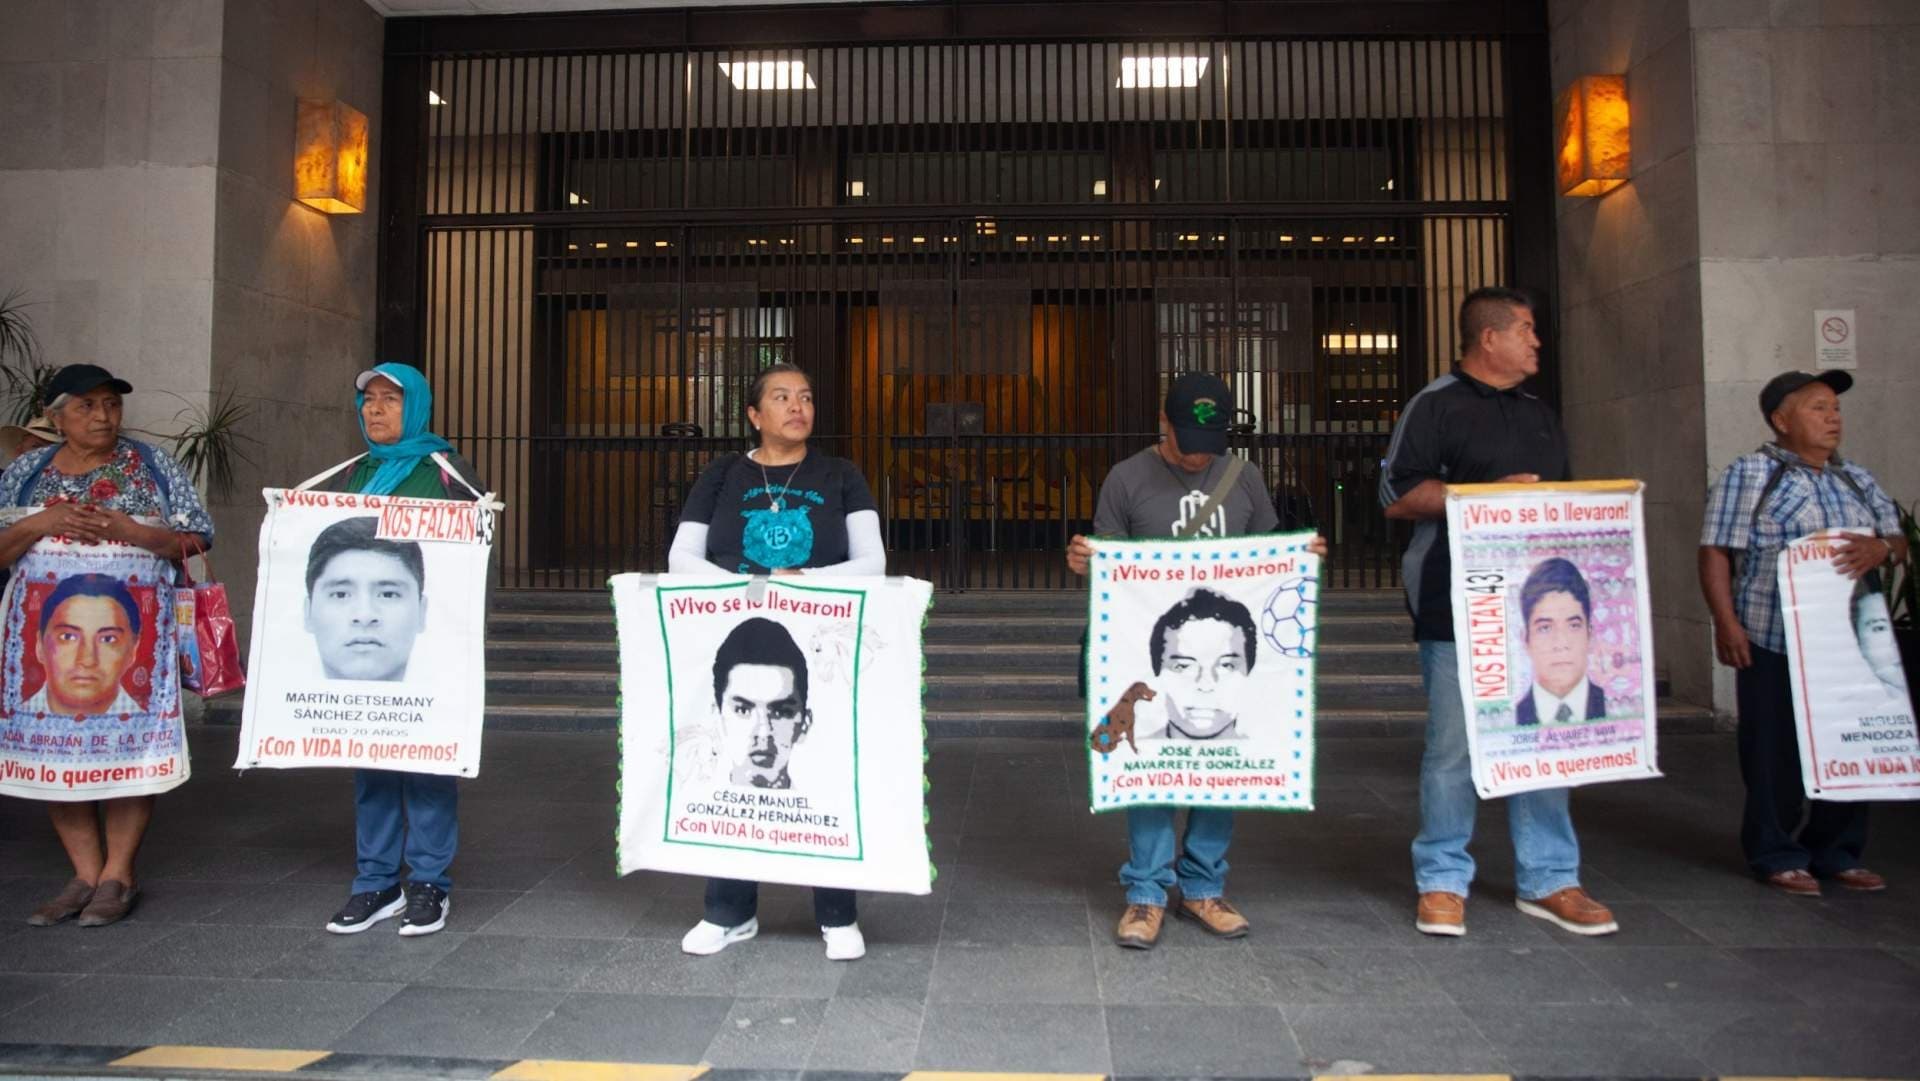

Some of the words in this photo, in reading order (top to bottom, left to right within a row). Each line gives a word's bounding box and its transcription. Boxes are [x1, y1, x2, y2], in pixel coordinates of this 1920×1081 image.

[335, 495, 357, 508] se
[379, 504, 413, 537] NOS
[1463, 502, 1512, 530] ¡Vivo
[1518, 505, 1538, 523] se
[1543, 502, 1559, 521] lo
[1563, 501, 1629, 521] llevaron!
[1112, 564, 1160, 582] ¡Vivo
[1166, 569, 1185, 581] se
[1191, 565, 1207, 581] lo
[1213, 558, 1295, 580] llevaron!
[722, 598, 742, 613] se
[768, 590, 852, 618] llevaron!
[1475, 661, 1505, 698] NOS
[285, 692, 339, 704] MARTÍN
[343, 694, 435, 707] GETSEMANY
[293, 708, 363, 721] SÁNCHEZ
[367, 711, 424, 723] GARCÍA
[30, 733, 82, 747] ABRAJÁN
[91, 735, 108, 746] DE
[118, 733, 135, 745] LA
[142, 730, 173, 743] CRUZ
[311, 726, 348, 735] EDAD
[372, 727, 409, 737] AÑOS
[1840, 729, 1914, 742] MENDOZA
[257, 736, 295, 758] ¡Con
[302, 737, 342, 757] VIDA
[347, 739, 364, 758] lo
[368, 742, 458, 763] queremos!
[0, 759, 35, 780] ¡Vivo
[41, 765, 56, 782] lo
[63, 758, 174, 788] queremos!
[1124, 760, 1199, 771] NAVARRETE
[1490, 761, 1532, 786] ¡Vivo
[1535, 759, 1551, 776] lo
[1556, 747, 1638, 777] queremos!
[1824, 760, 1860, 780] ¡Con
[1864, 757, 1907, 775] VIDA
[1112, 775, 1143, 793] ¡Con
[1147, 773, 1184, 788] VIDA
[1189, 773, 1202, 786] lo
[1207, 774, 1286, 789] queremos!
[713, 791, 755, 805] CÉSAR
[758, 795, 812, 809] MANUEL
[758, 808, 839, 827] HERNÁNDEZ
[675, 817, 707, 834] ¡Con
[712, 820, 747, 837] VIDA
[752, 824, 764, 840] lo
[769, 828, 849, 847] queremos!
